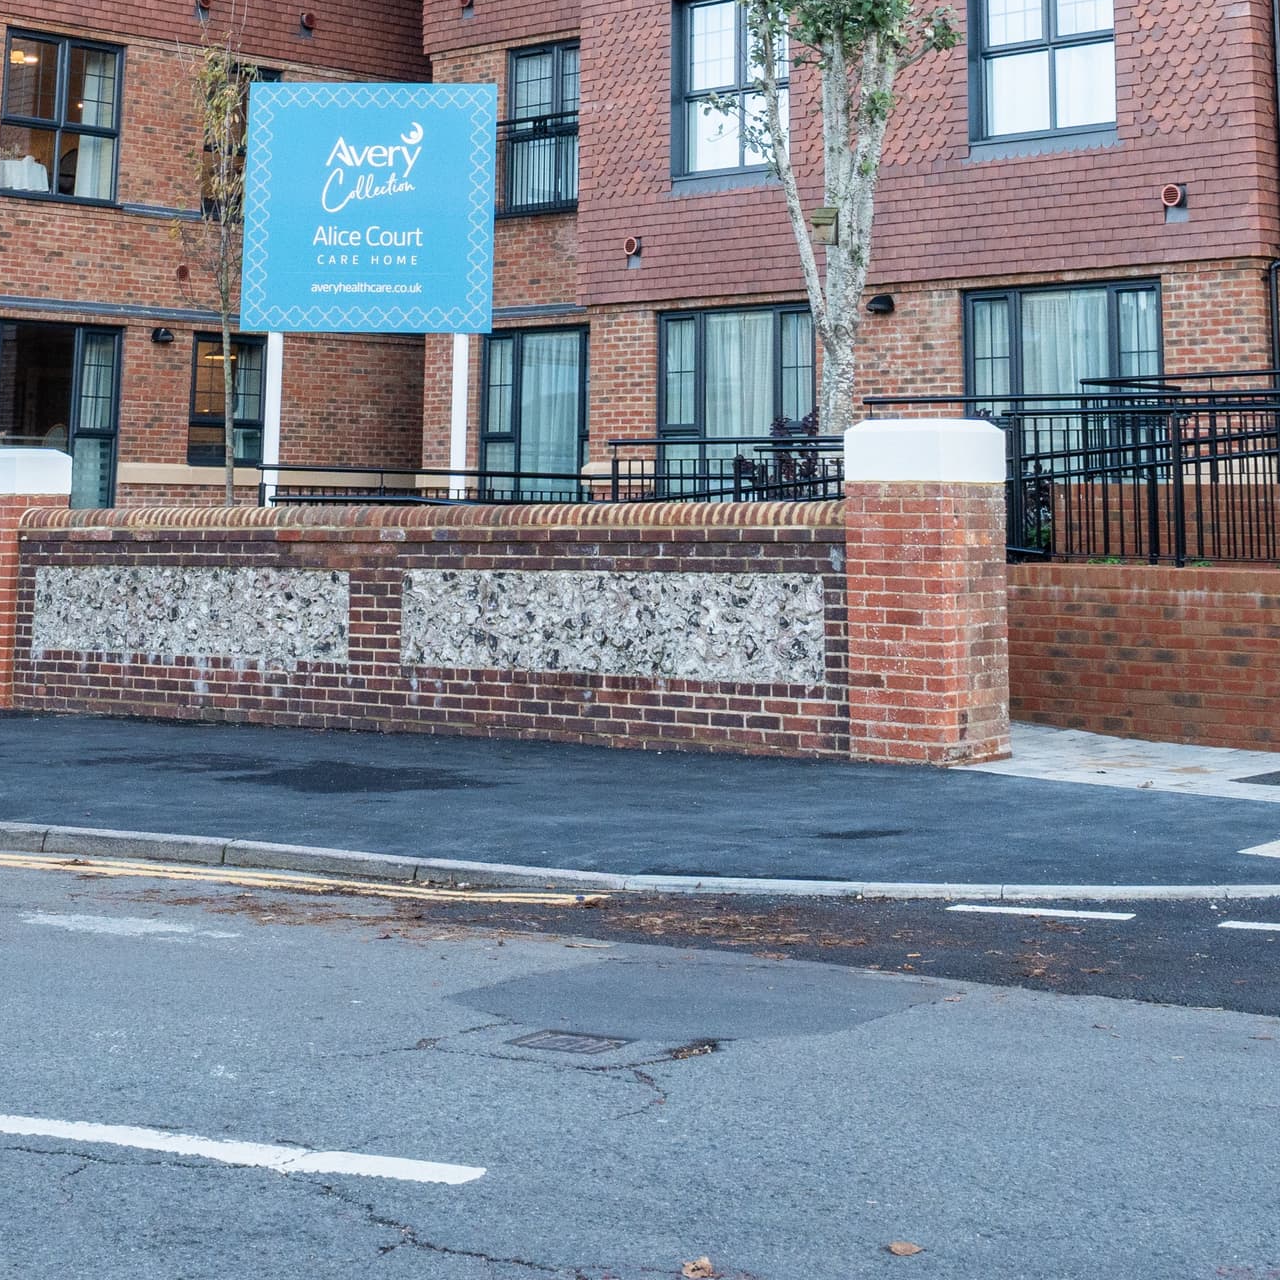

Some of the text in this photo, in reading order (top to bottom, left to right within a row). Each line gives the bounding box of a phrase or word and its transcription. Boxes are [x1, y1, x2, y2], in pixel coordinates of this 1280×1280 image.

[325, 136, 422, 178] Avery
[322, 168, 416, 213] Collection
[313, 226, 423, 247] Alice Court
[317, 255, 417, 266] CARE HOME
[311, 282, 422, 295] averyhealthcare.co.uk
